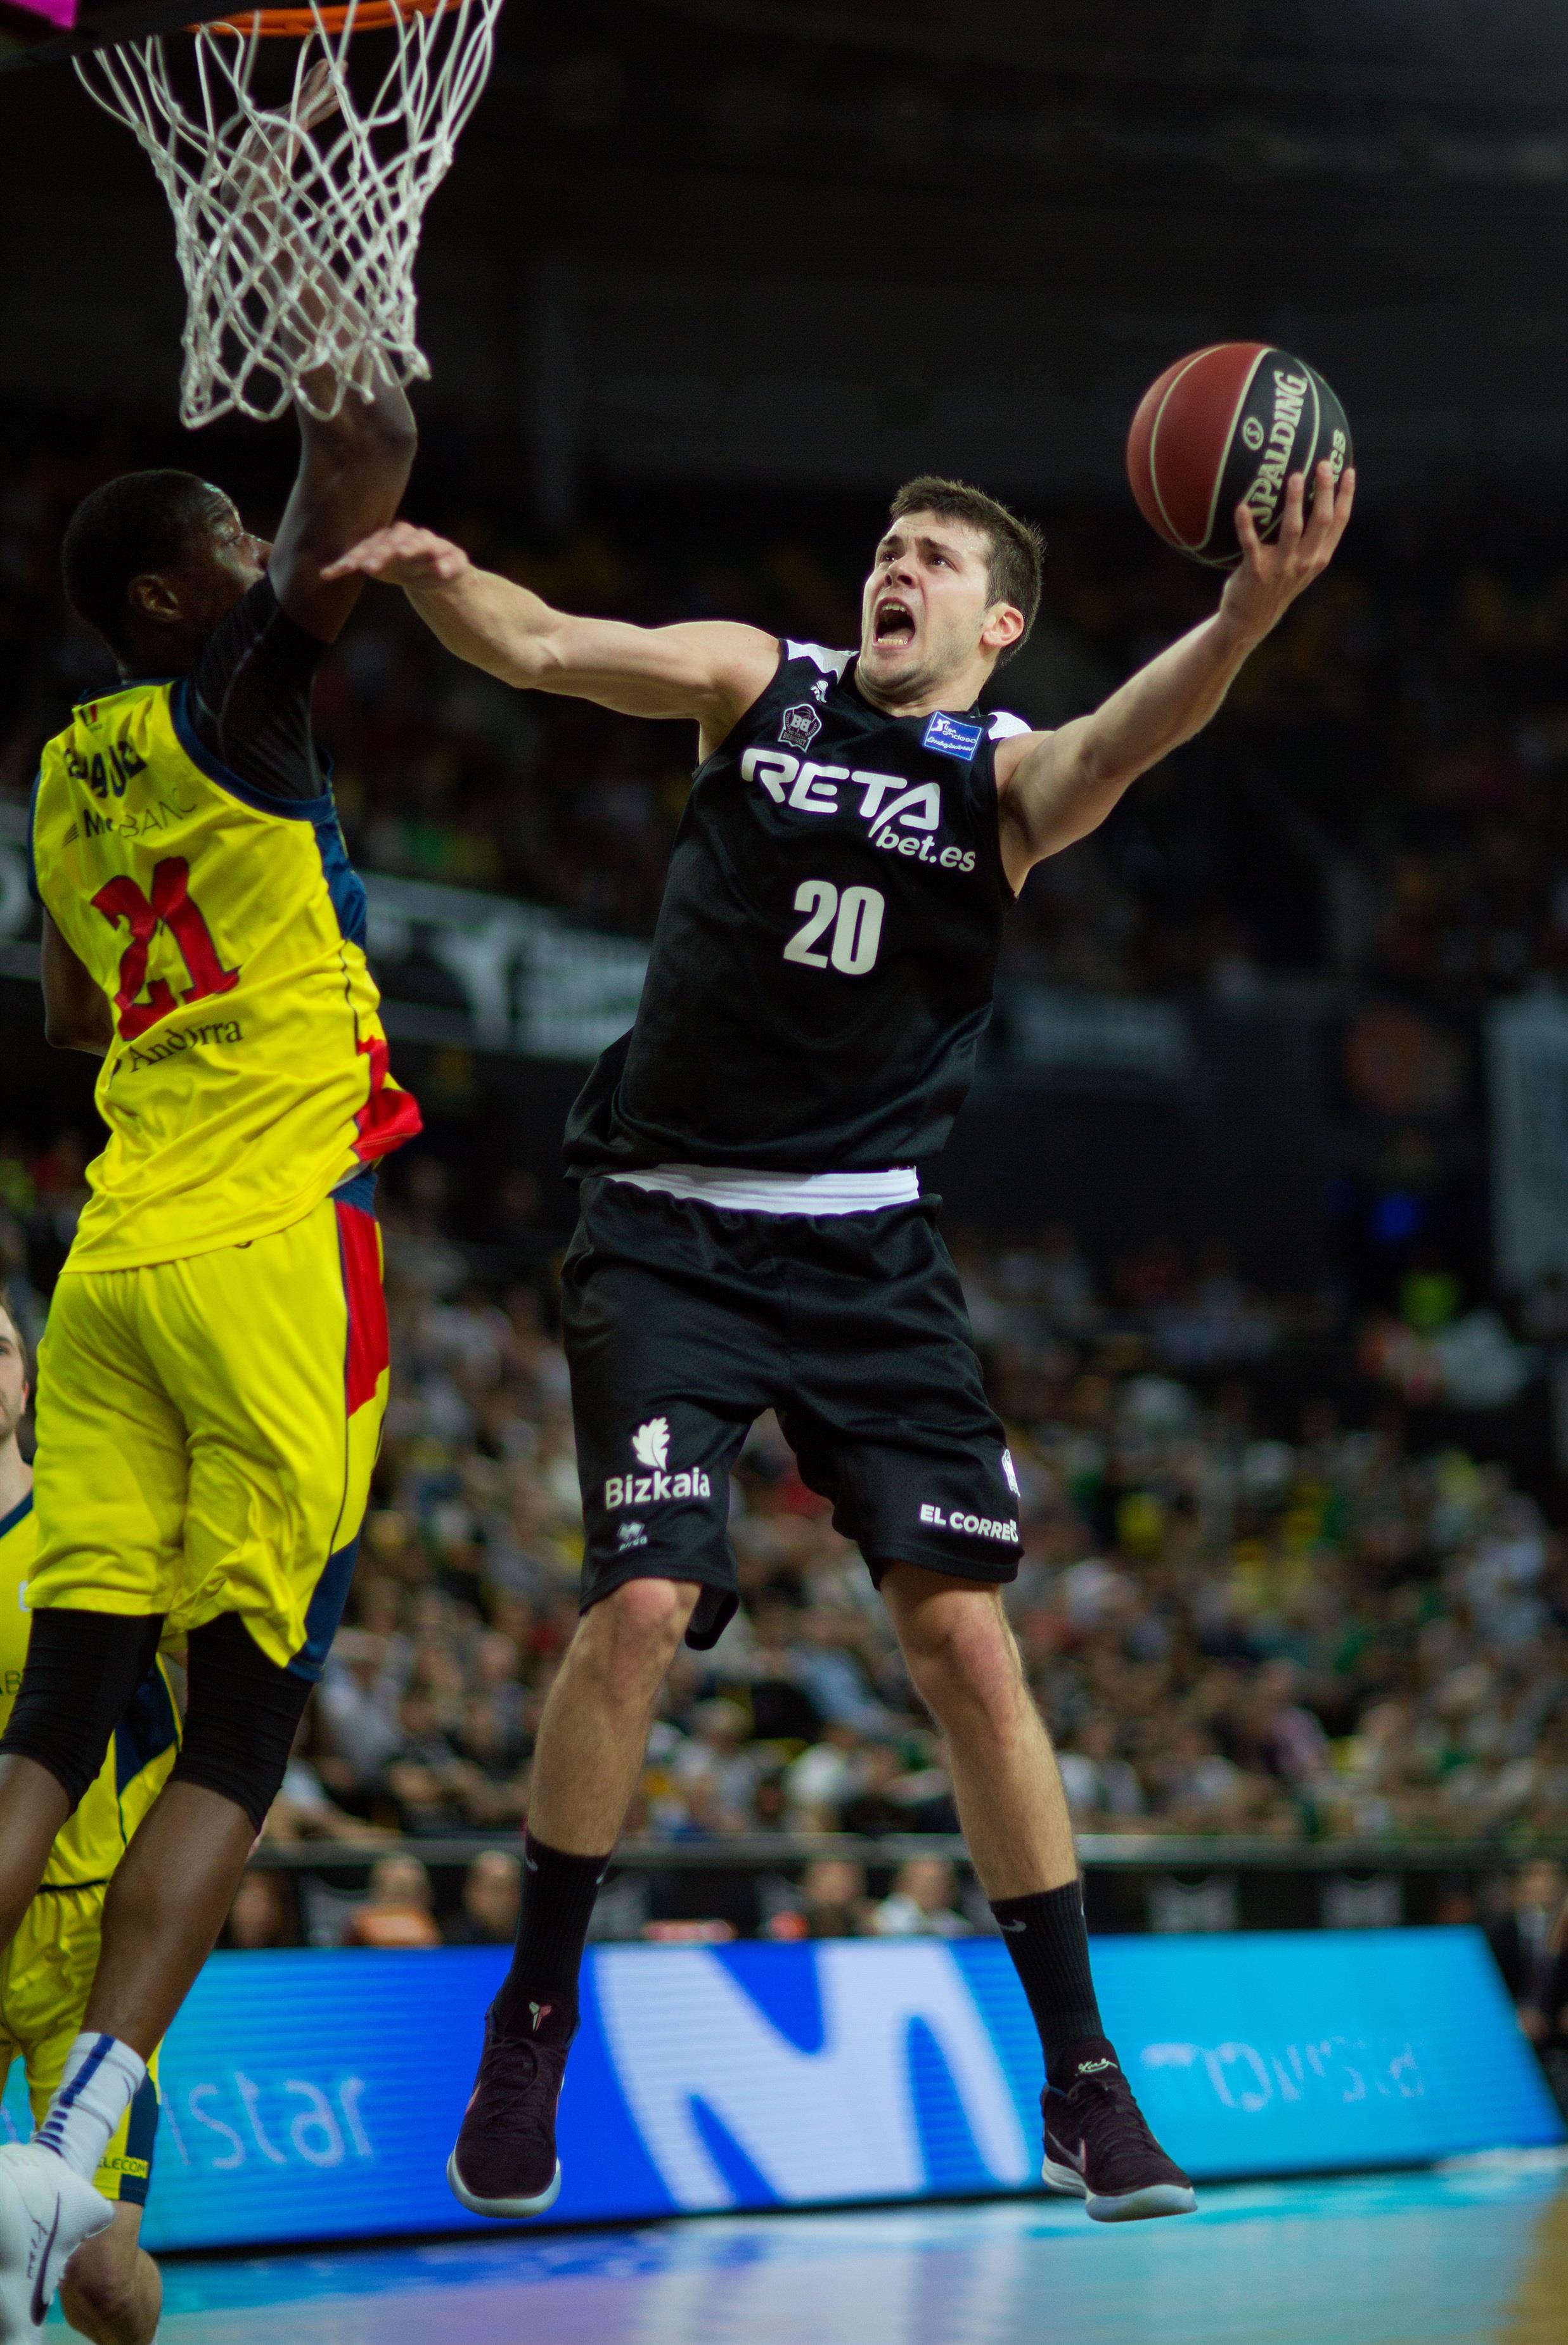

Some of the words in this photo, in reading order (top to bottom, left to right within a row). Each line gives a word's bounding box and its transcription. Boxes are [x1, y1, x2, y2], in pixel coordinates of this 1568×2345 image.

[942, 730, 977, 743] endesa
[741, 748, 941, 838] RETA
[876, 826, 975, 872] bet.es
[91, 857, 240, 1041] 21
[783, 880, 885, 975] 20
[605, 1467, 710, 1510] Bizkaia
[920, 1503, 946, 1526] EL
